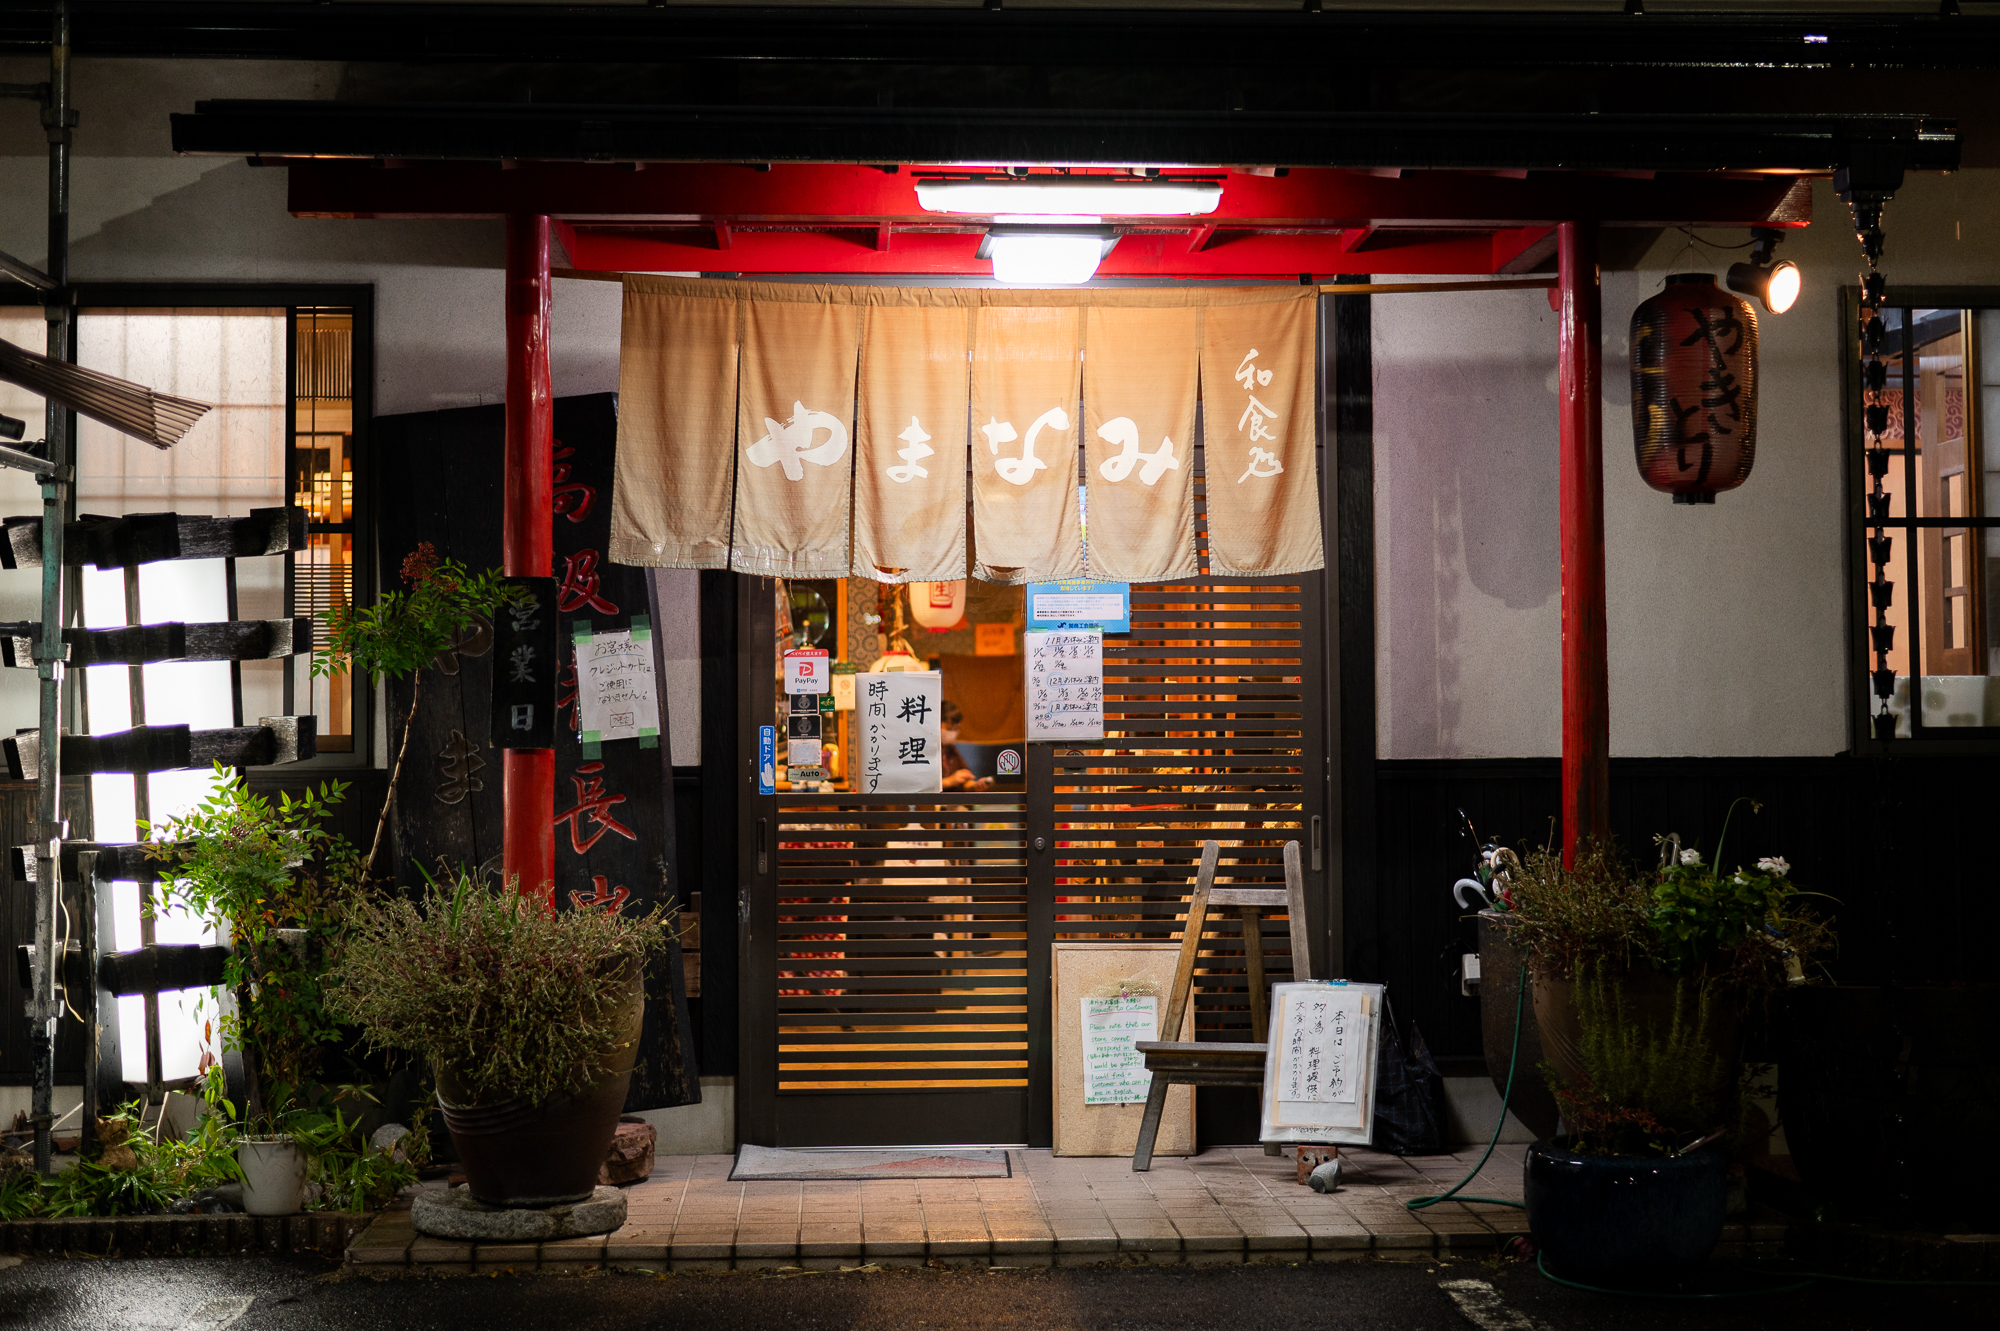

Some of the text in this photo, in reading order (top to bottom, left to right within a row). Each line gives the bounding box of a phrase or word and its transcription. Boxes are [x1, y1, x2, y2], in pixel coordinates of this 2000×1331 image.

[1669, 305, 1742, 486] やきとり
[1235, 348, 1283, 484] 和食処
[745, 400, 1179, 486] やまなみ
[508, 594, 542, 732] 営業日
[598, 678, 633, 693] ご使用に
[763, 728, 771, 761] 自動ドア
[865, 680, 889, 794] 時間かかります
[896, 694, 933, 765] 料理
[1090, 1006, 1113, 1014] Request
[1094, 1061, 1108, 1069] would
[1120, 1059, 1143, 1068] grateful
[1096, 1044, 1121, 1052] respond
[1328, 1010, 1346, 1098] 本日はご予約が
[1091, 1081, 1117, 1089] customer
[1095, 1072, 1109, 1080] could
[1112, 1071, 1125, 1079] find
[1114, 1088, 1133, 1097] English
